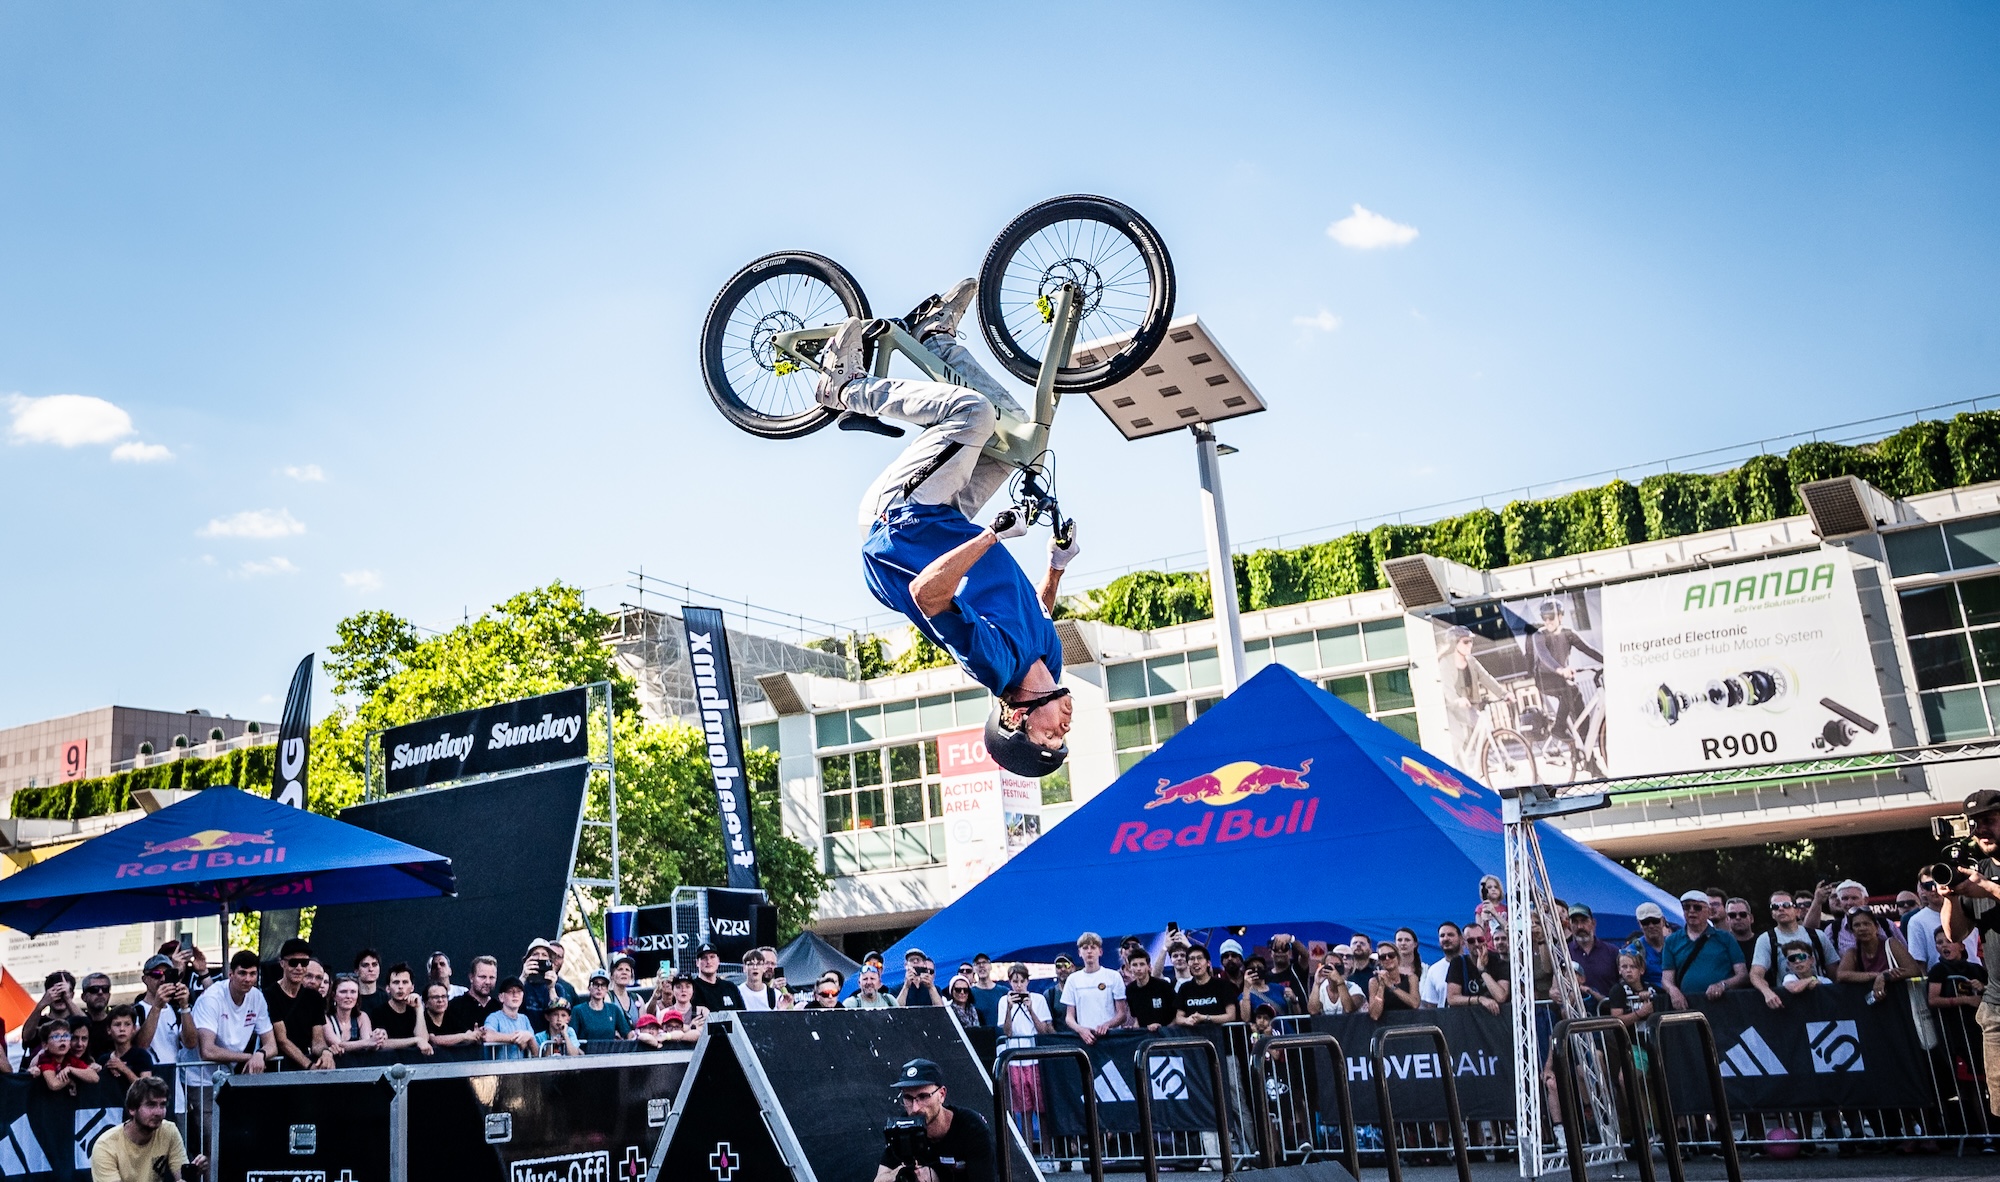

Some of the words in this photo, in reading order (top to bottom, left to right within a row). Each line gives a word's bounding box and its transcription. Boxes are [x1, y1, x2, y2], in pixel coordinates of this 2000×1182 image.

[1683, 563, 1835, 611] ANANDA
[1619, 634, 1681, 653] Integrated
[1685, 624, 1748, 643] Electronic
[1621, 650, 1669, 668] 3-Speed
[1673, 646, 1701, 660] Gear
[1705, 641, 1730, 655] Hub
[1734, 636, 1771, 650] Motor
[1775, 629, 1824, 645] System
[391, 733, 474, 771] Sunday
[488, 713, 581, 750] Sunday
[948, 741, 987, 767] F10
[1700, 730, 1778, 761] R900
[67, 745, 79, 777] 9
[944, 780, 993, 797] ACTION
[1002, 778, 1038, 790] HIGHLIGHTS
[1003, 789, 1030, 799] FESTIVAL
[945, 799, 980, 813] AREA
[1109, 811, 1215, 854] Red
[1215, 797, 1320, 843] Bull
[115, 853, 199, 879] Red
[206, 847, 286, 868] Bull
